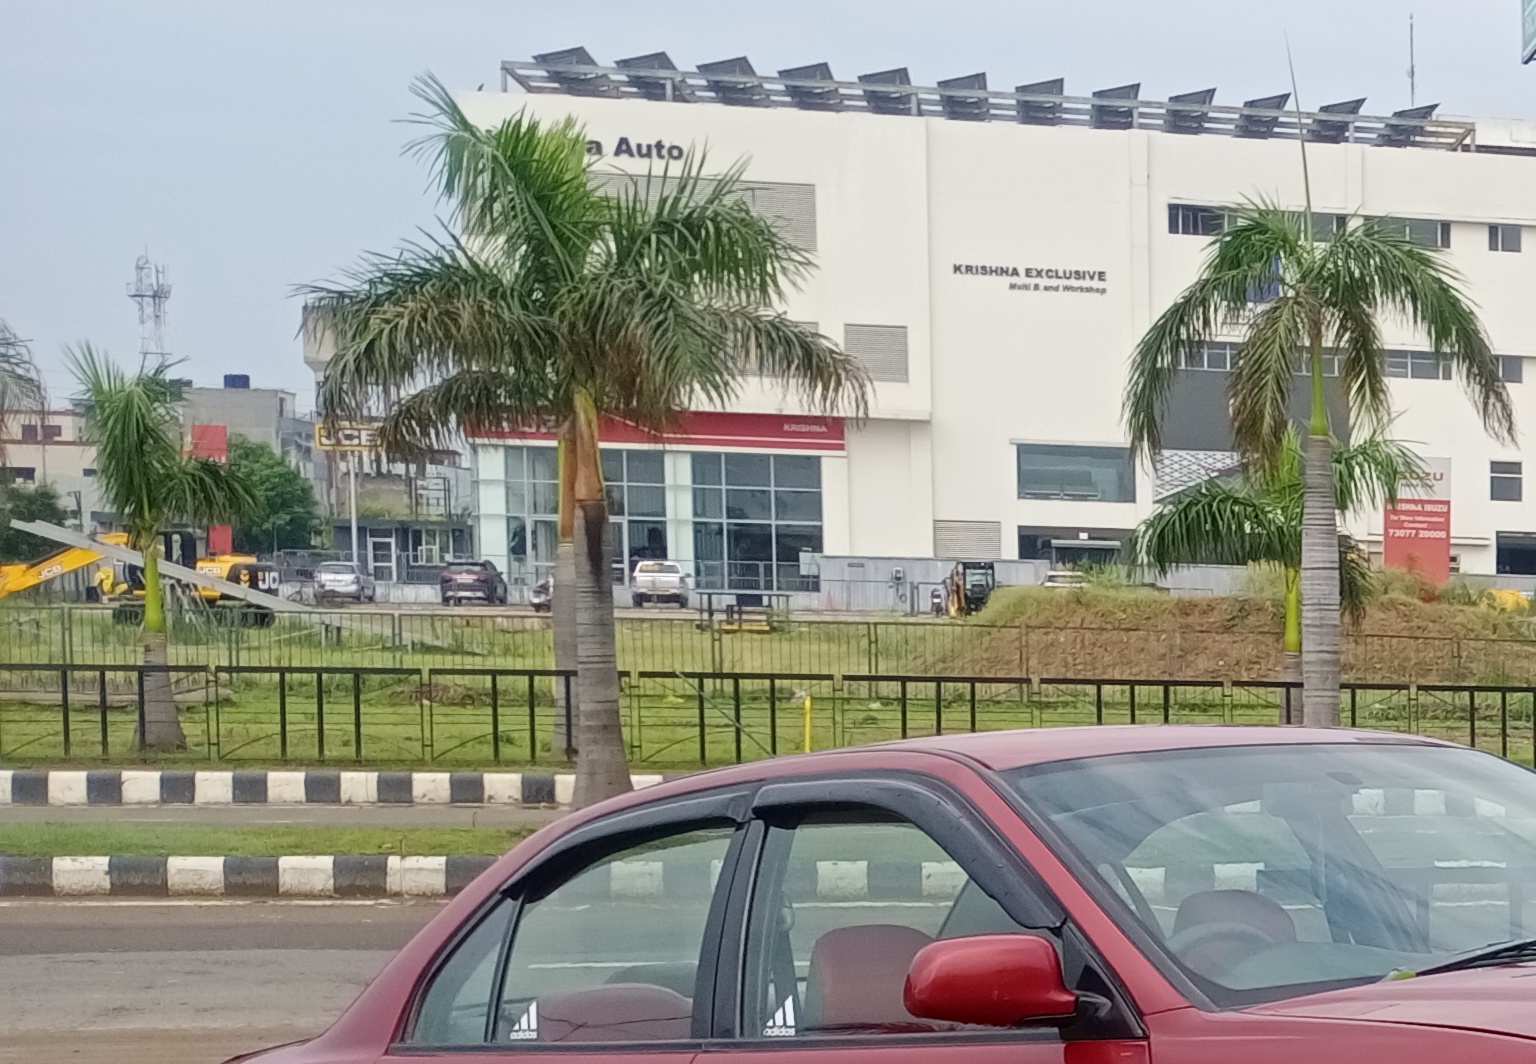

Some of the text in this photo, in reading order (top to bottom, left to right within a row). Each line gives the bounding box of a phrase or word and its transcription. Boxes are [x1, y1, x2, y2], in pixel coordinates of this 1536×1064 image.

[613, 136, 684, 160] Auto
[952, 263, 1107, 282] KRISHNA EXCLUSIVE
